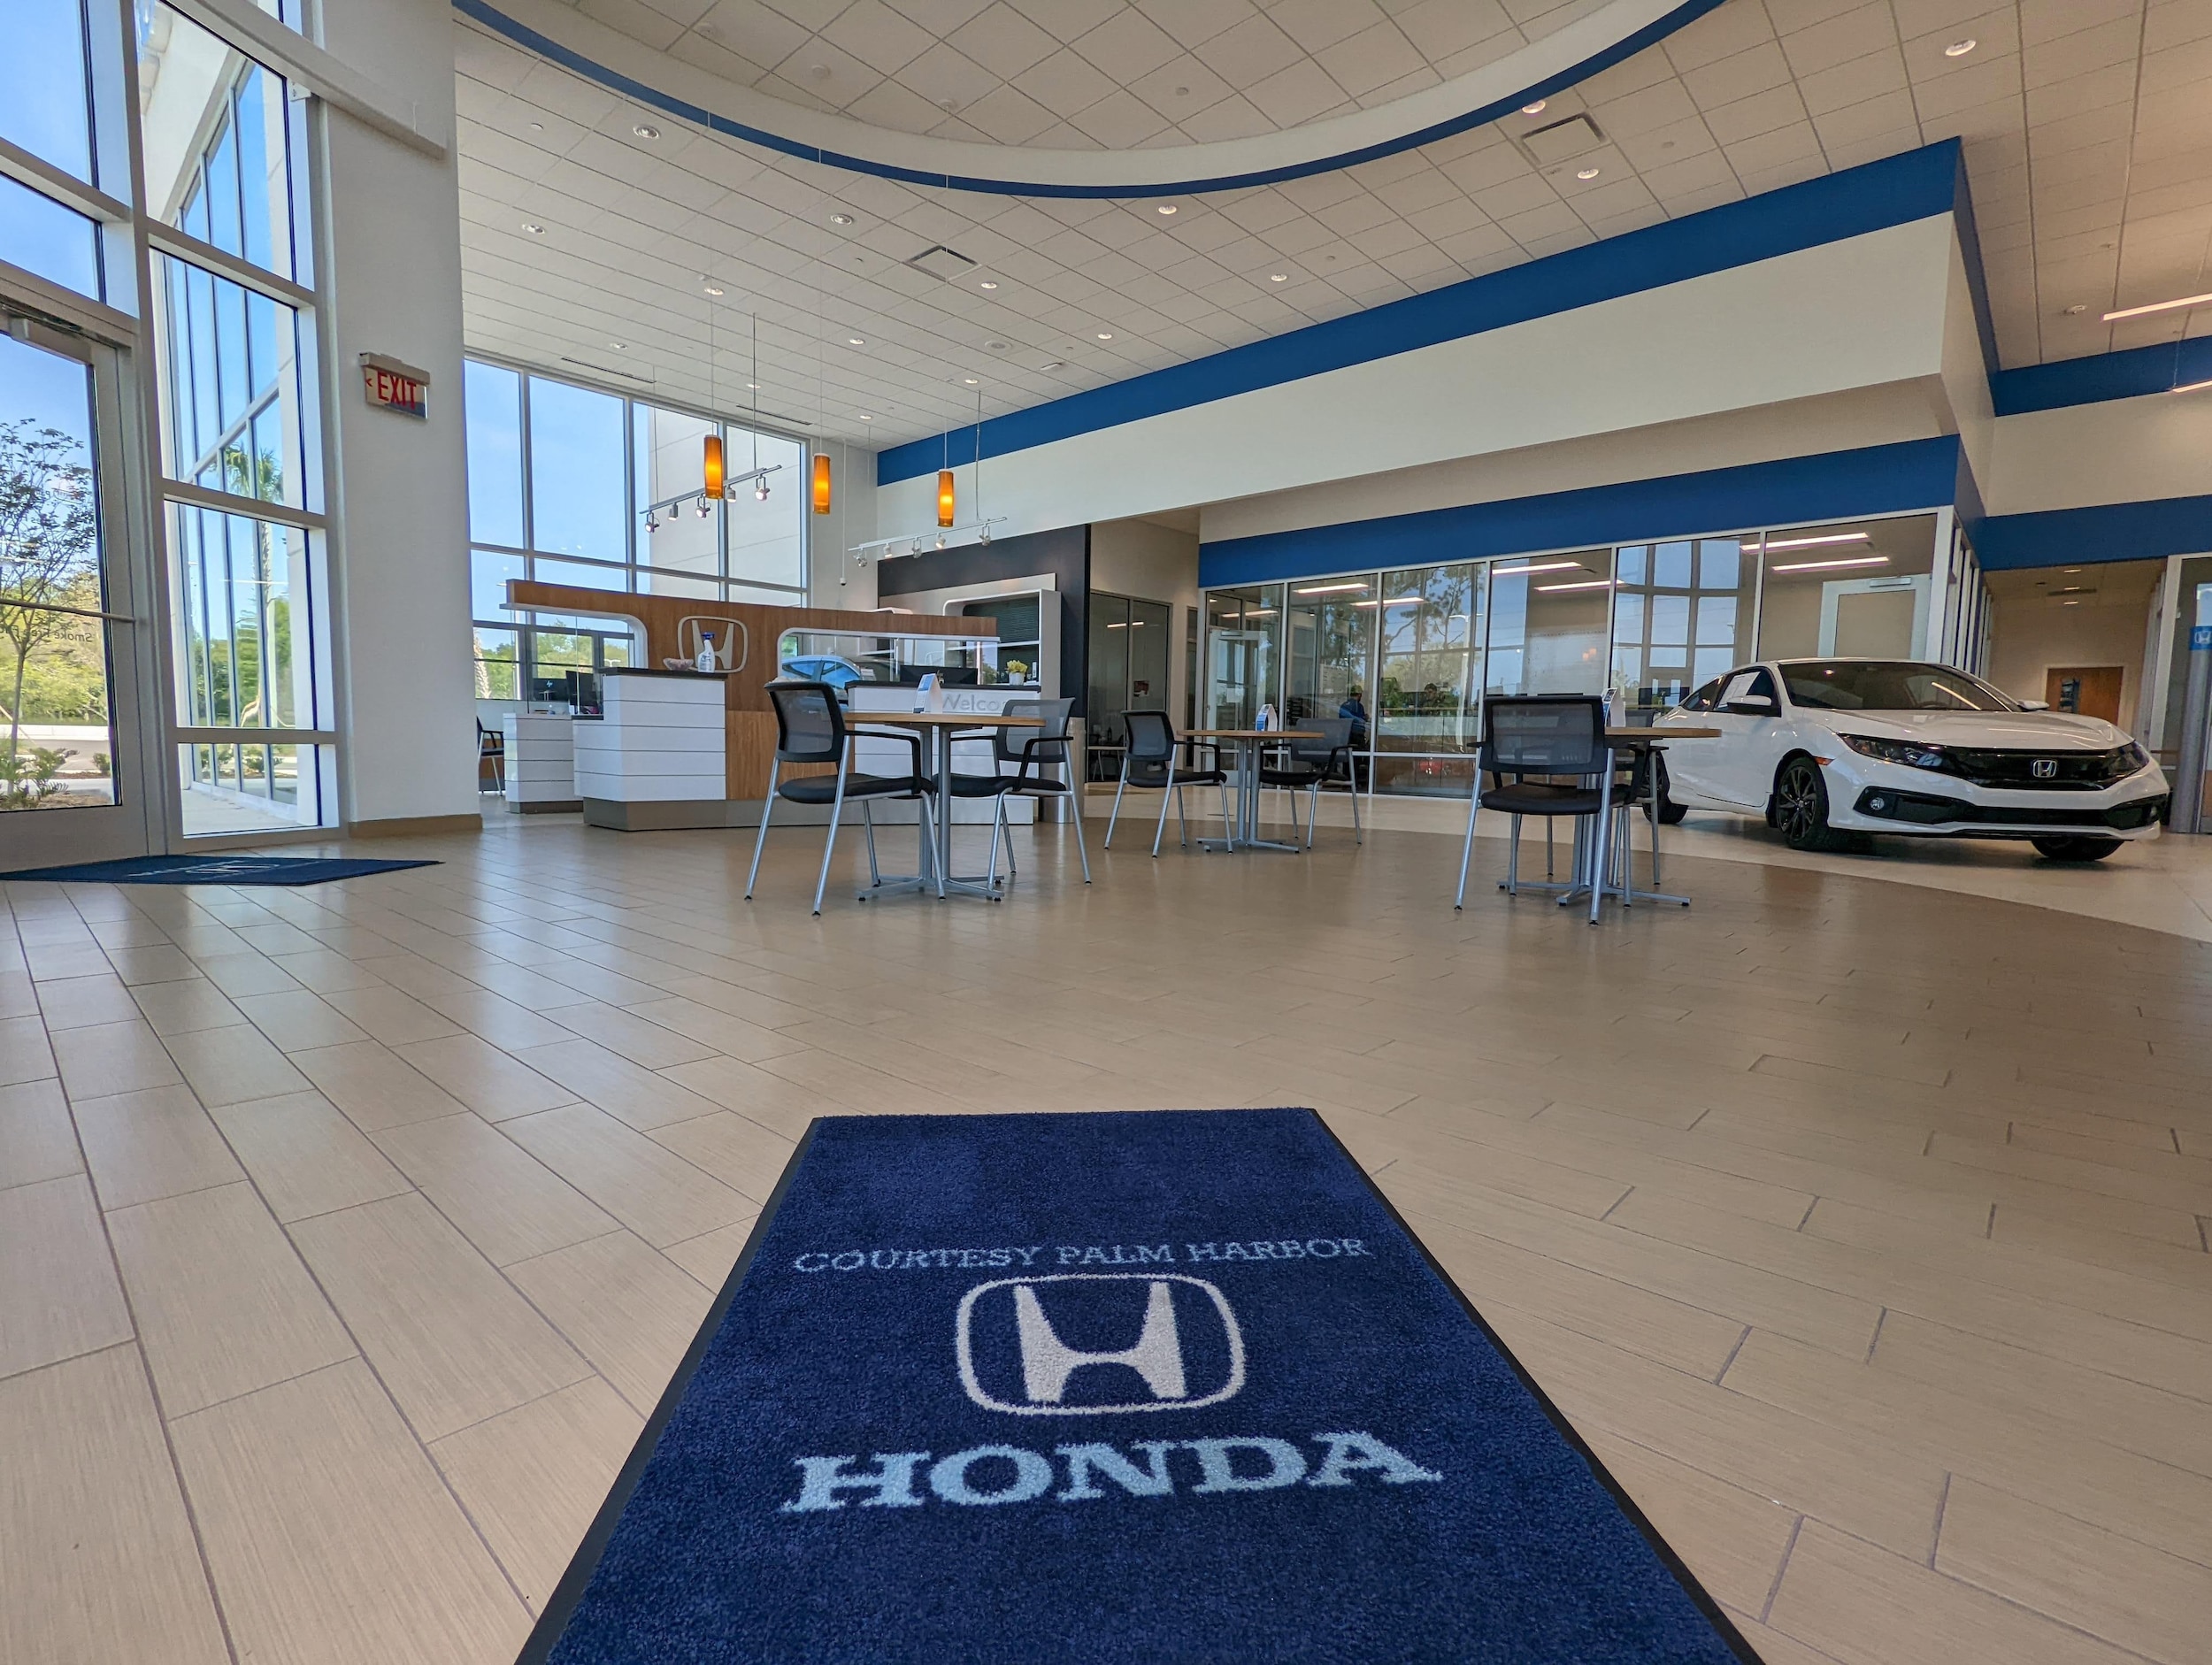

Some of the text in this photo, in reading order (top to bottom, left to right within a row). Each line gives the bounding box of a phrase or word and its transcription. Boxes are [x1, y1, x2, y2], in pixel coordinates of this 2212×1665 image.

[377, 371, 417, 410] EXIT
[942, 693, 1007, 711] Welco
[795, 1238, 1375, 1273] COURTESY PALM HARBOR
[782, 1430, 1444, 1511] HONDA
